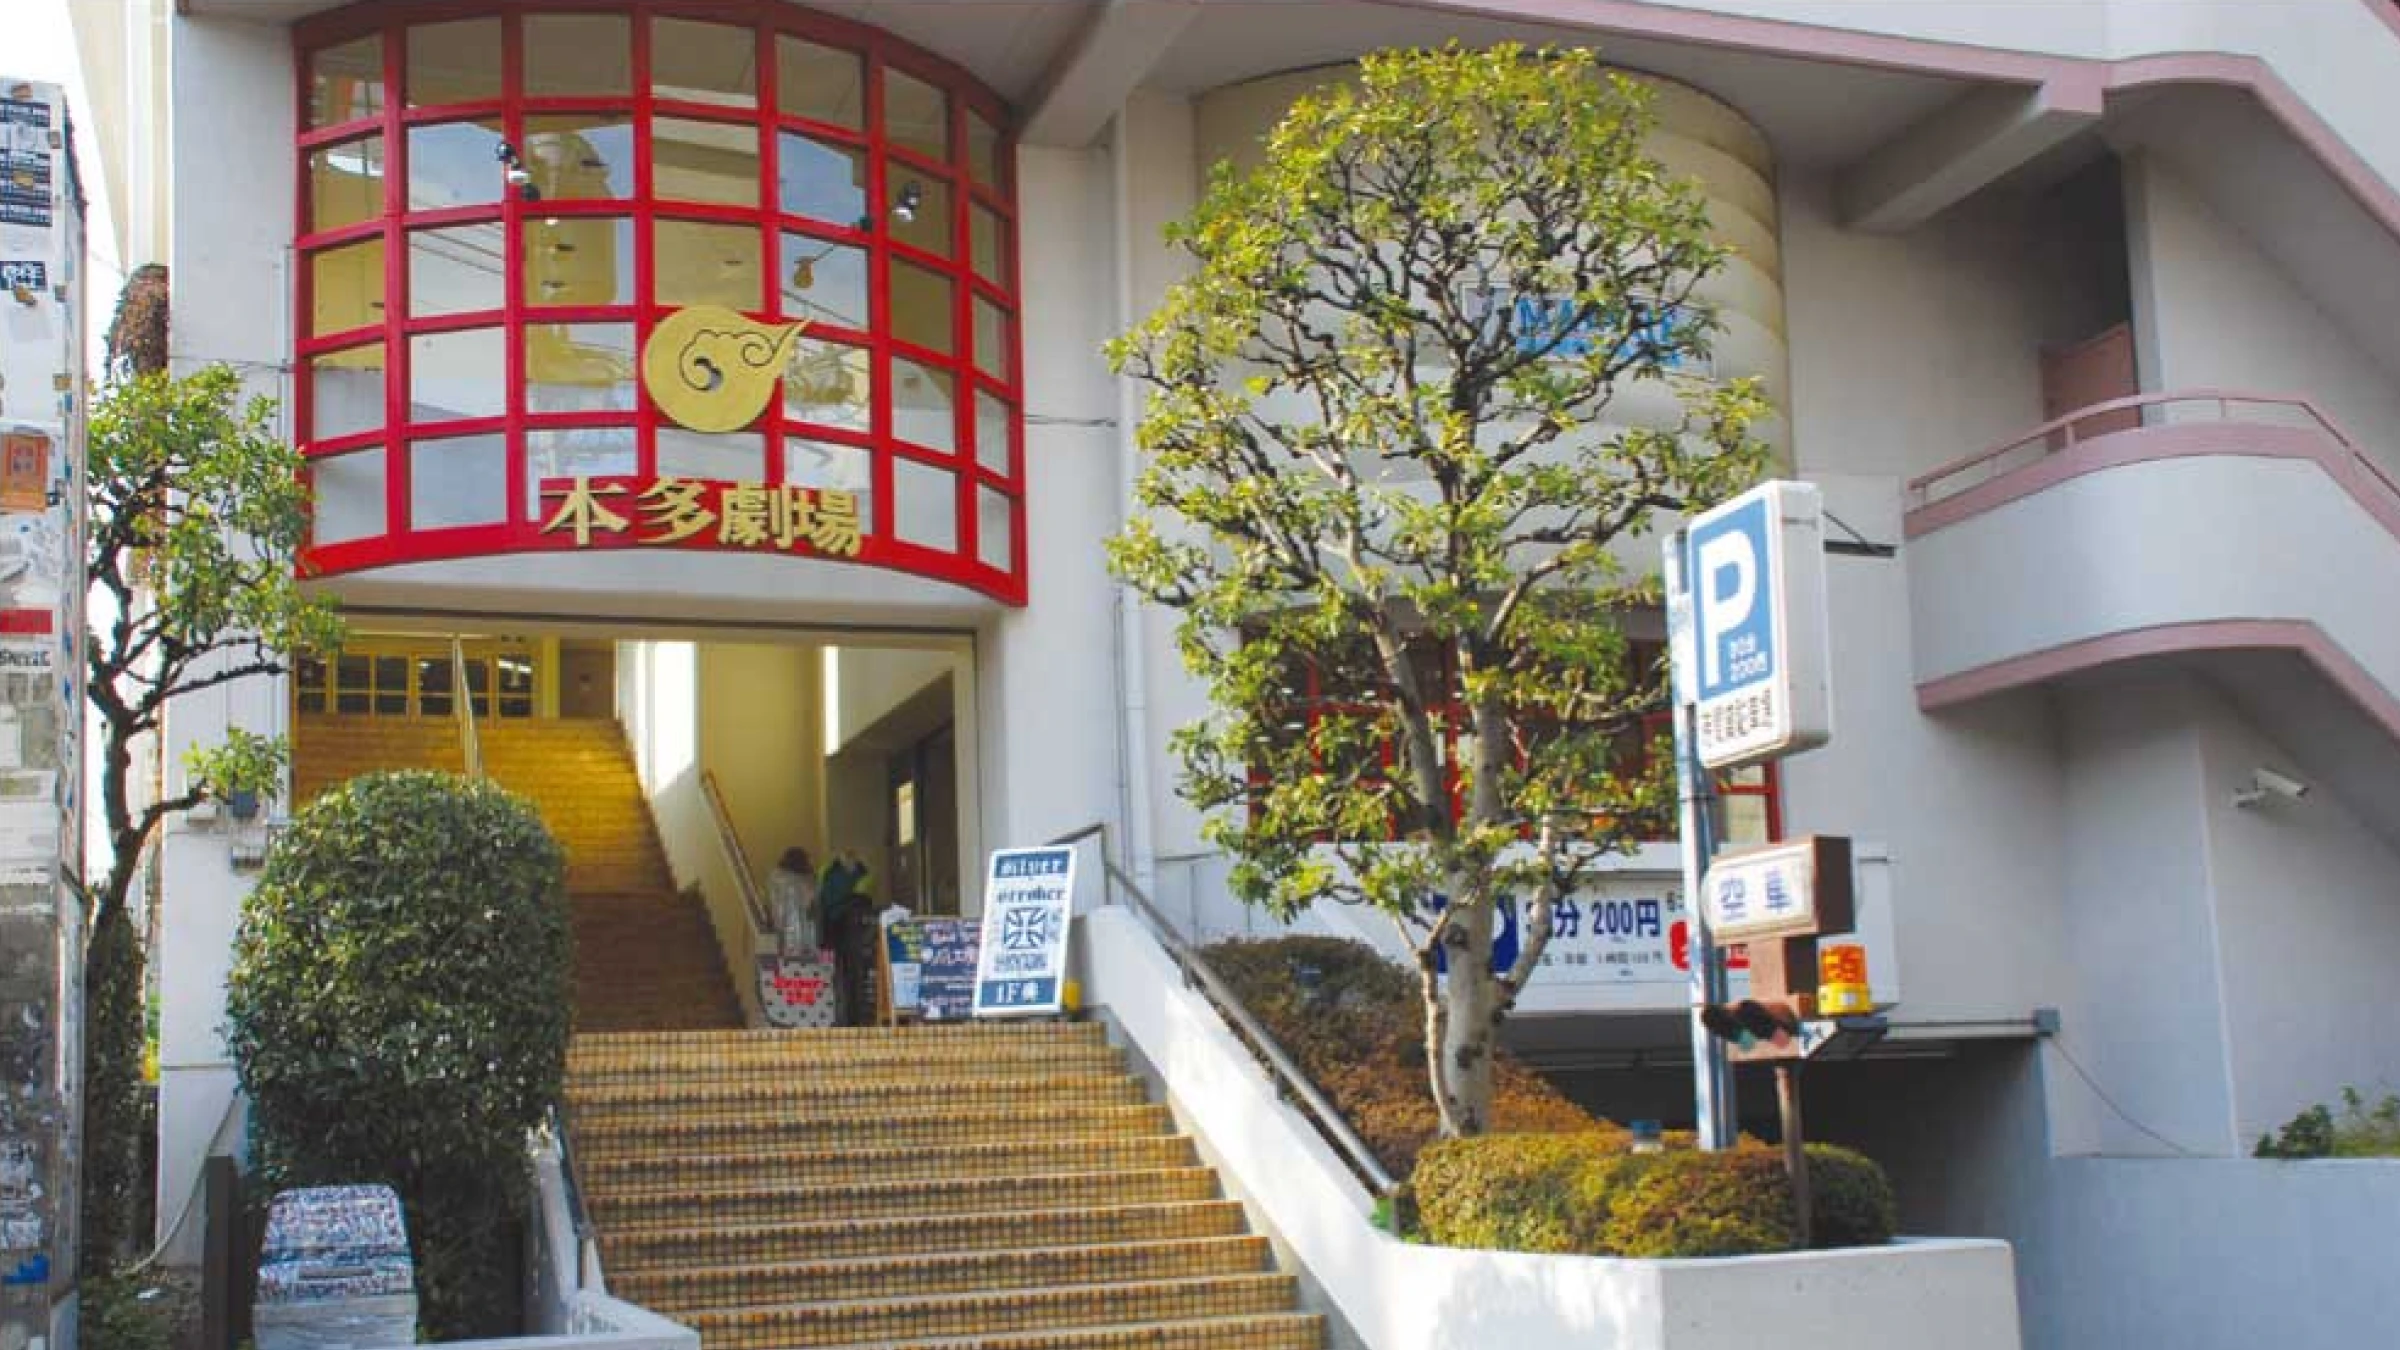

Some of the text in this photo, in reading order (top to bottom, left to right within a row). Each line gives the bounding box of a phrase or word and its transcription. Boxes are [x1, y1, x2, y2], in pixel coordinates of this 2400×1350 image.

[540, 475, 863, 557] 本多劇場
[1699, 530, 1757, 690] P
[1592, 899, 1661, 938] 200円
[1718, 866, 1792, 922] 空車
